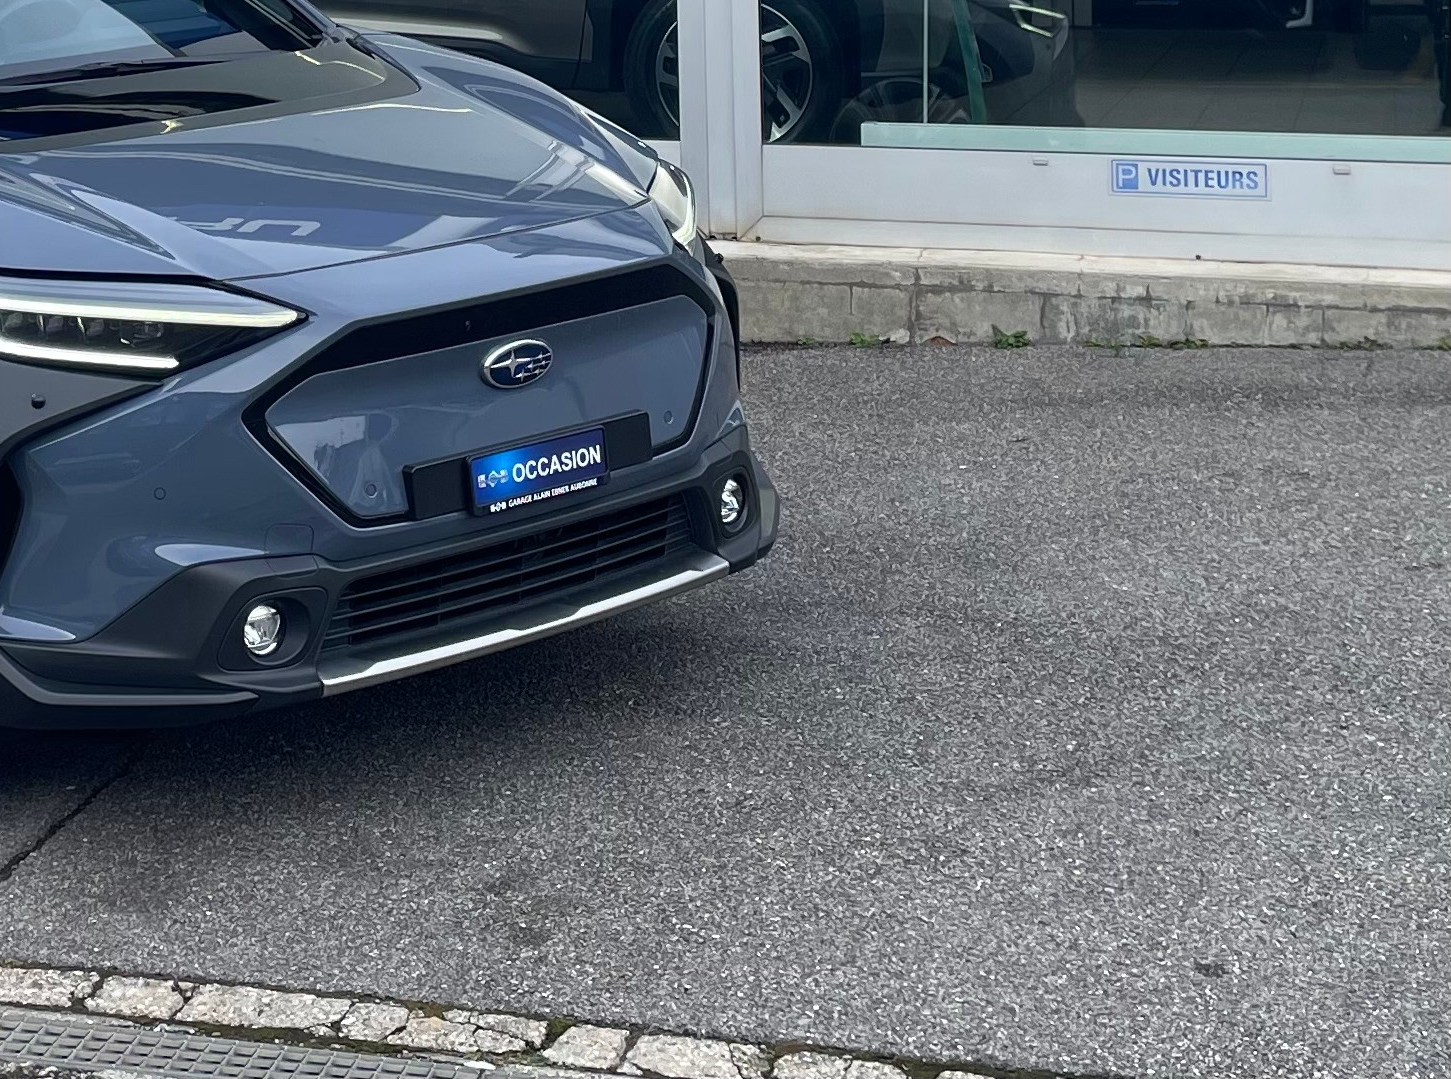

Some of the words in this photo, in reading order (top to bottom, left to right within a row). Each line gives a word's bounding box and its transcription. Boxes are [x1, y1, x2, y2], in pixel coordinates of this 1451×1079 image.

[1118, 165, 1136, 188] P
[1147, 167, 1259, 190] VISITEURS
[512, 444, 601, 482] OCCASION
